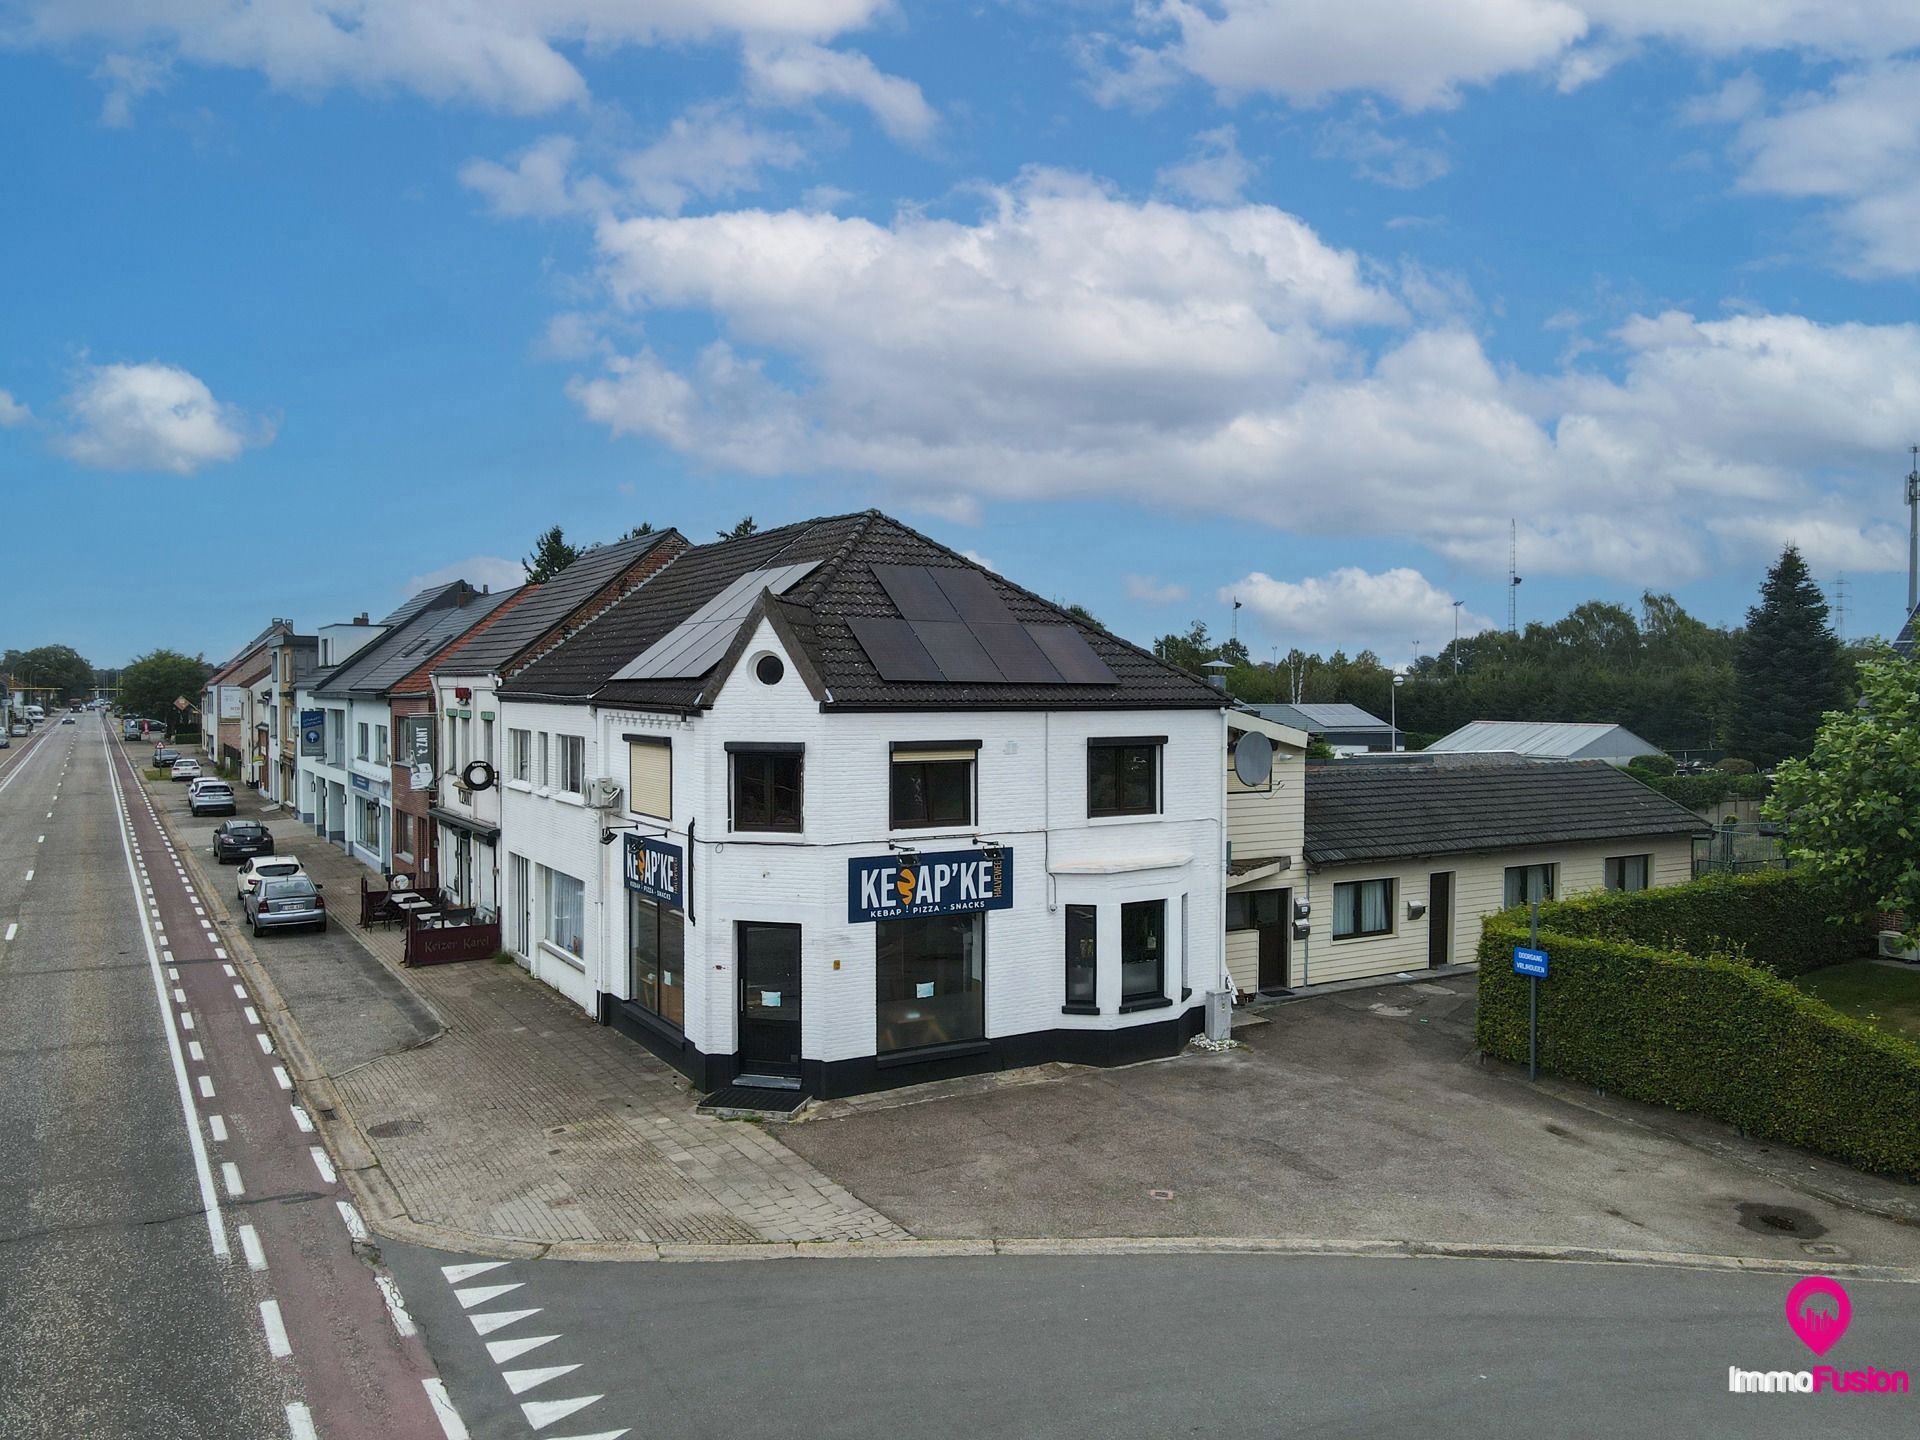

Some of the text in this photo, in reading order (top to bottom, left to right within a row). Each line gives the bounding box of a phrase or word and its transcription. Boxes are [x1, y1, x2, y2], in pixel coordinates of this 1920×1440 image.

[416, 727, 428, 748] ZANT
[870, 901, 985, 918] KEBAP PIZZA SNACKS
[463, 936, 490, 950] Karel
[1518, 952, 1543, 962] DOORGANG
[1516, 962, 1545, 973] VRIJHOUDEN
